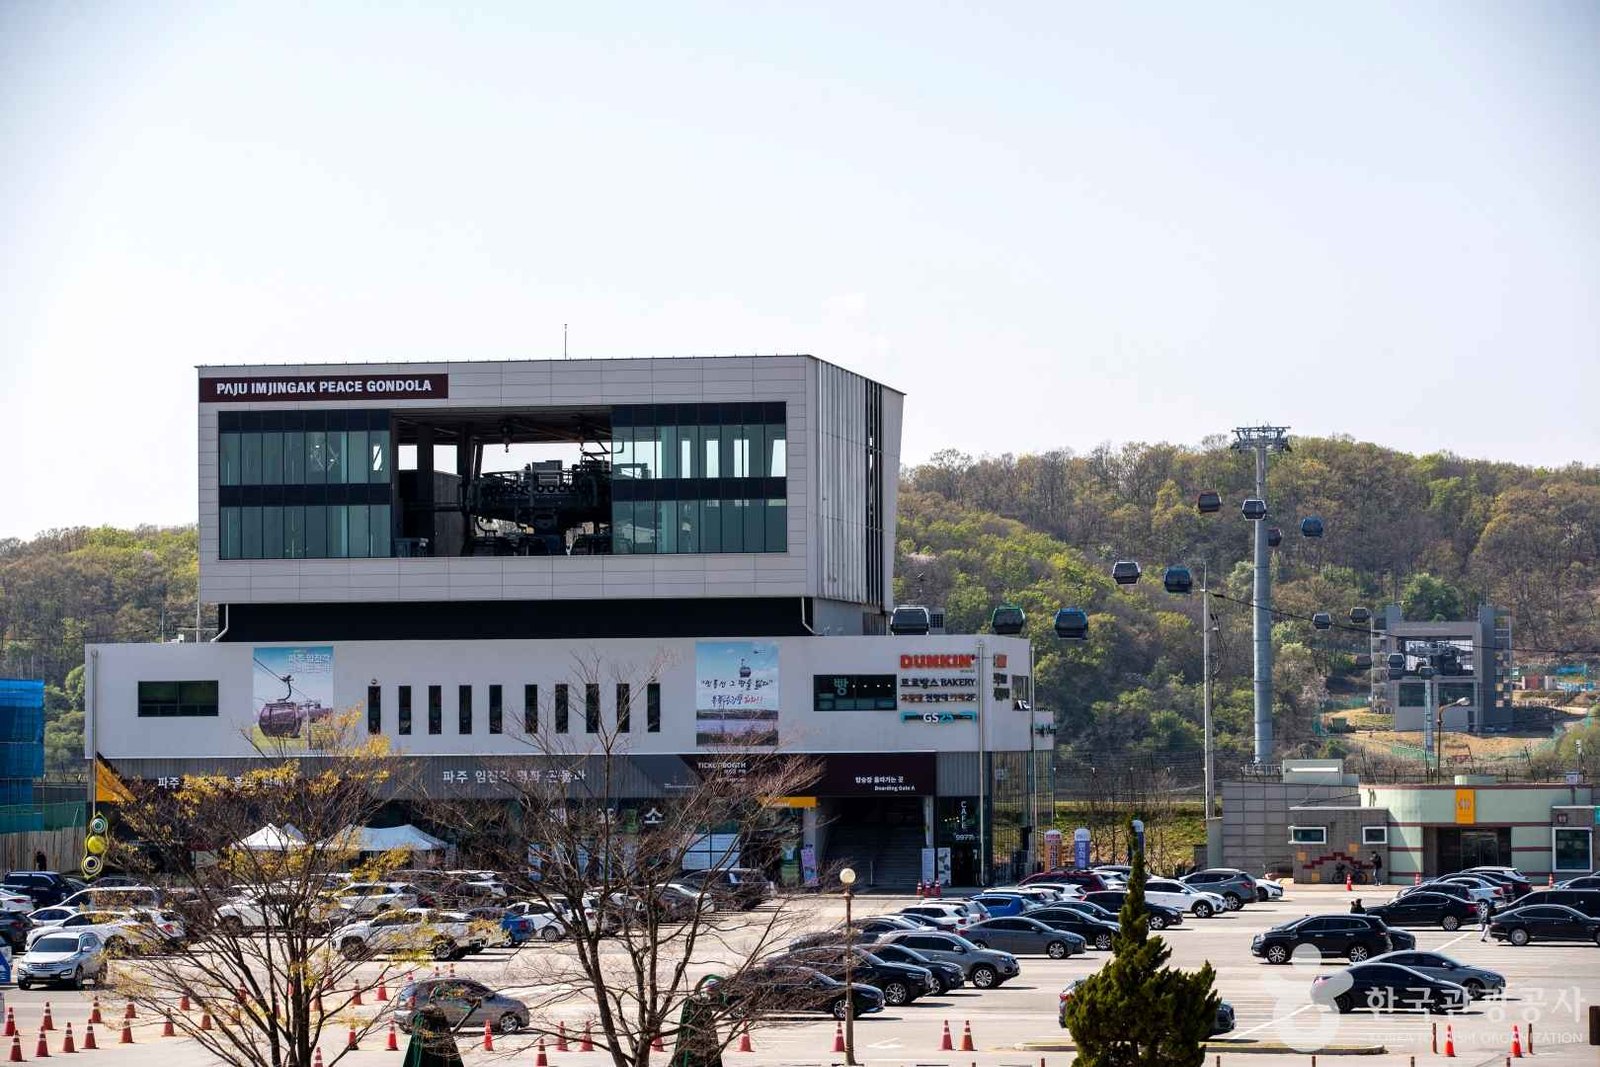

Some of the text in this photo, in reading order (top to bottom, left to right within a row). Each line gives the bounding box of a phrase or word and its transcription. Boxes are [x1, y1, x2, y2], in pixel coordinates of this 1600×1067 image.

[216, 380, 432, 396] PAJU IMJINGAK PEACE GONDOLA
[940, 678, 976, 687] BAKERY
[923, 712, 954, 723] GS25
[157, 776, 180, 790] 파주
[442, 770, 468, 784] 파주
